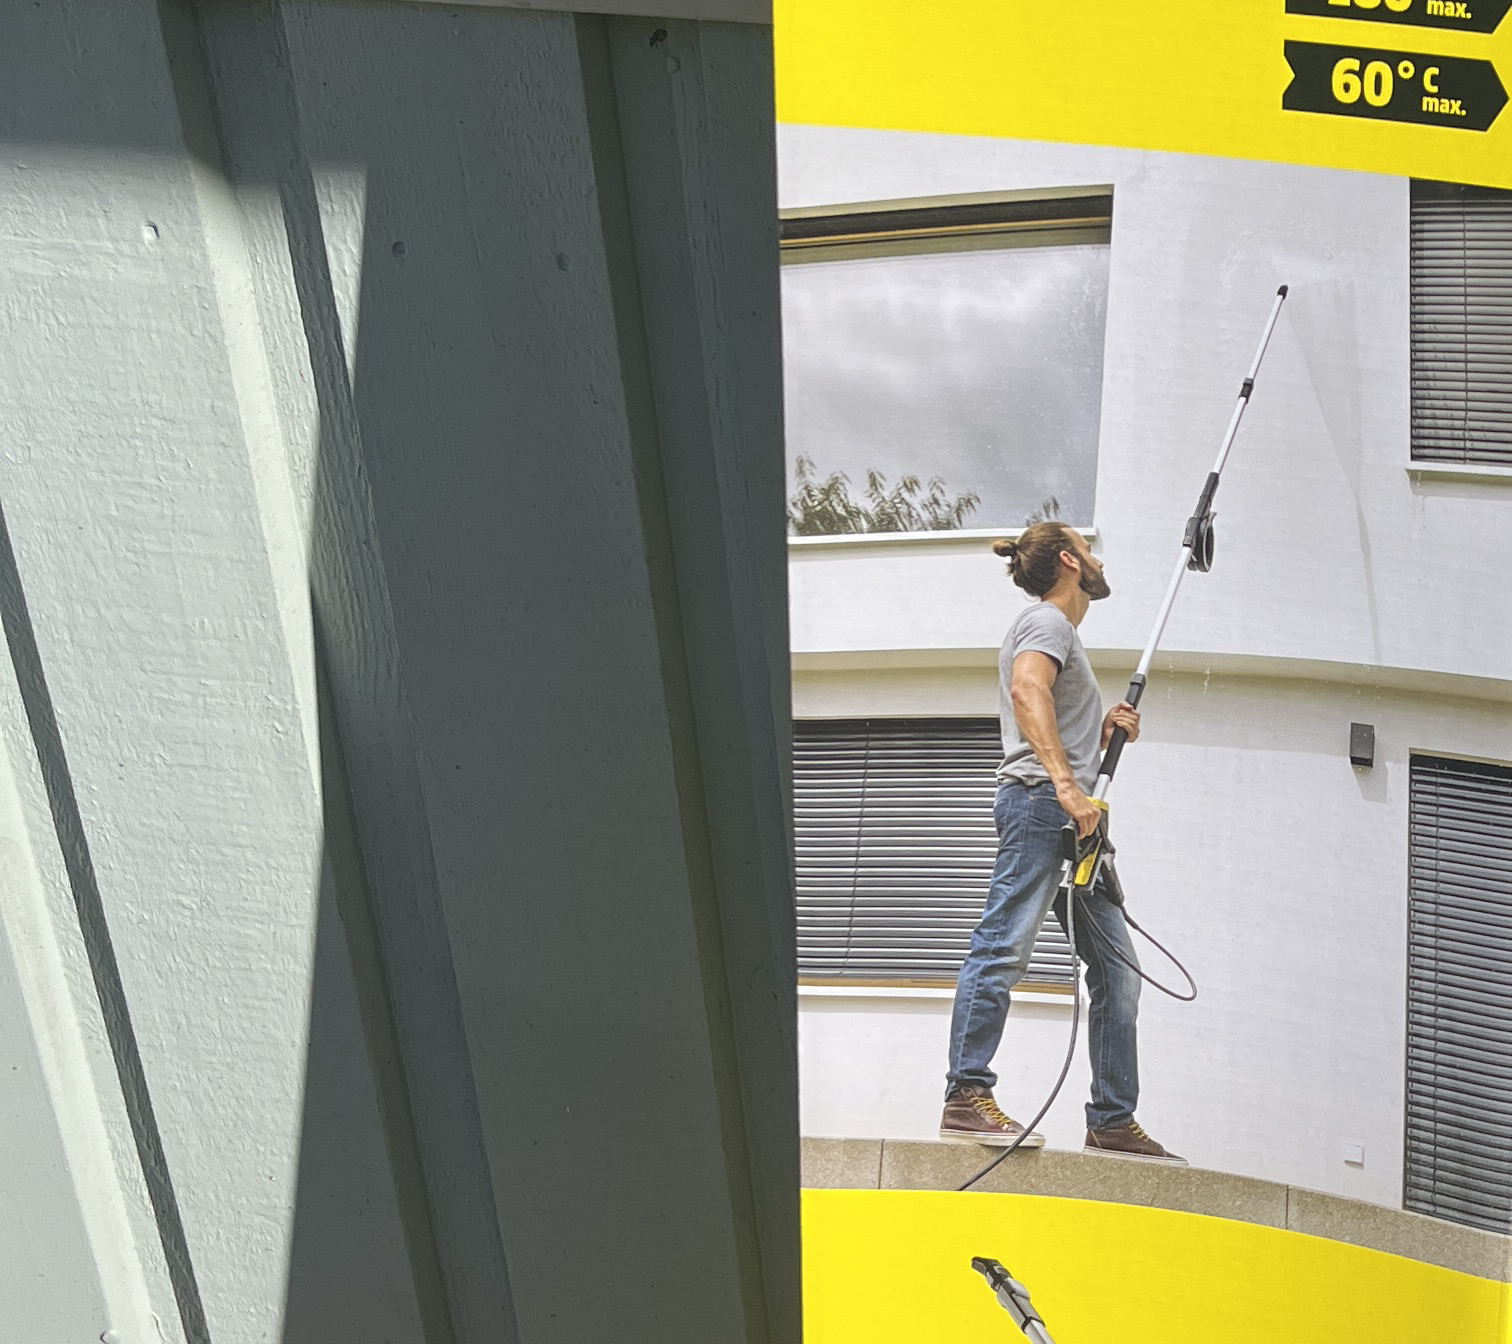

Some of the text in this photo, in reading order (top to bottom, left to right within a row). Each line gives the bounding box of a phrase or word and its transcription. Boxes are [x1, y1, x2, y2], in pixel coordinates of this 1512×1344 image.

[1426, 0, 1472, 19] max.
[1331, 57, 1415, 107] 60°
[1421, 96, 1467, 116] max.
